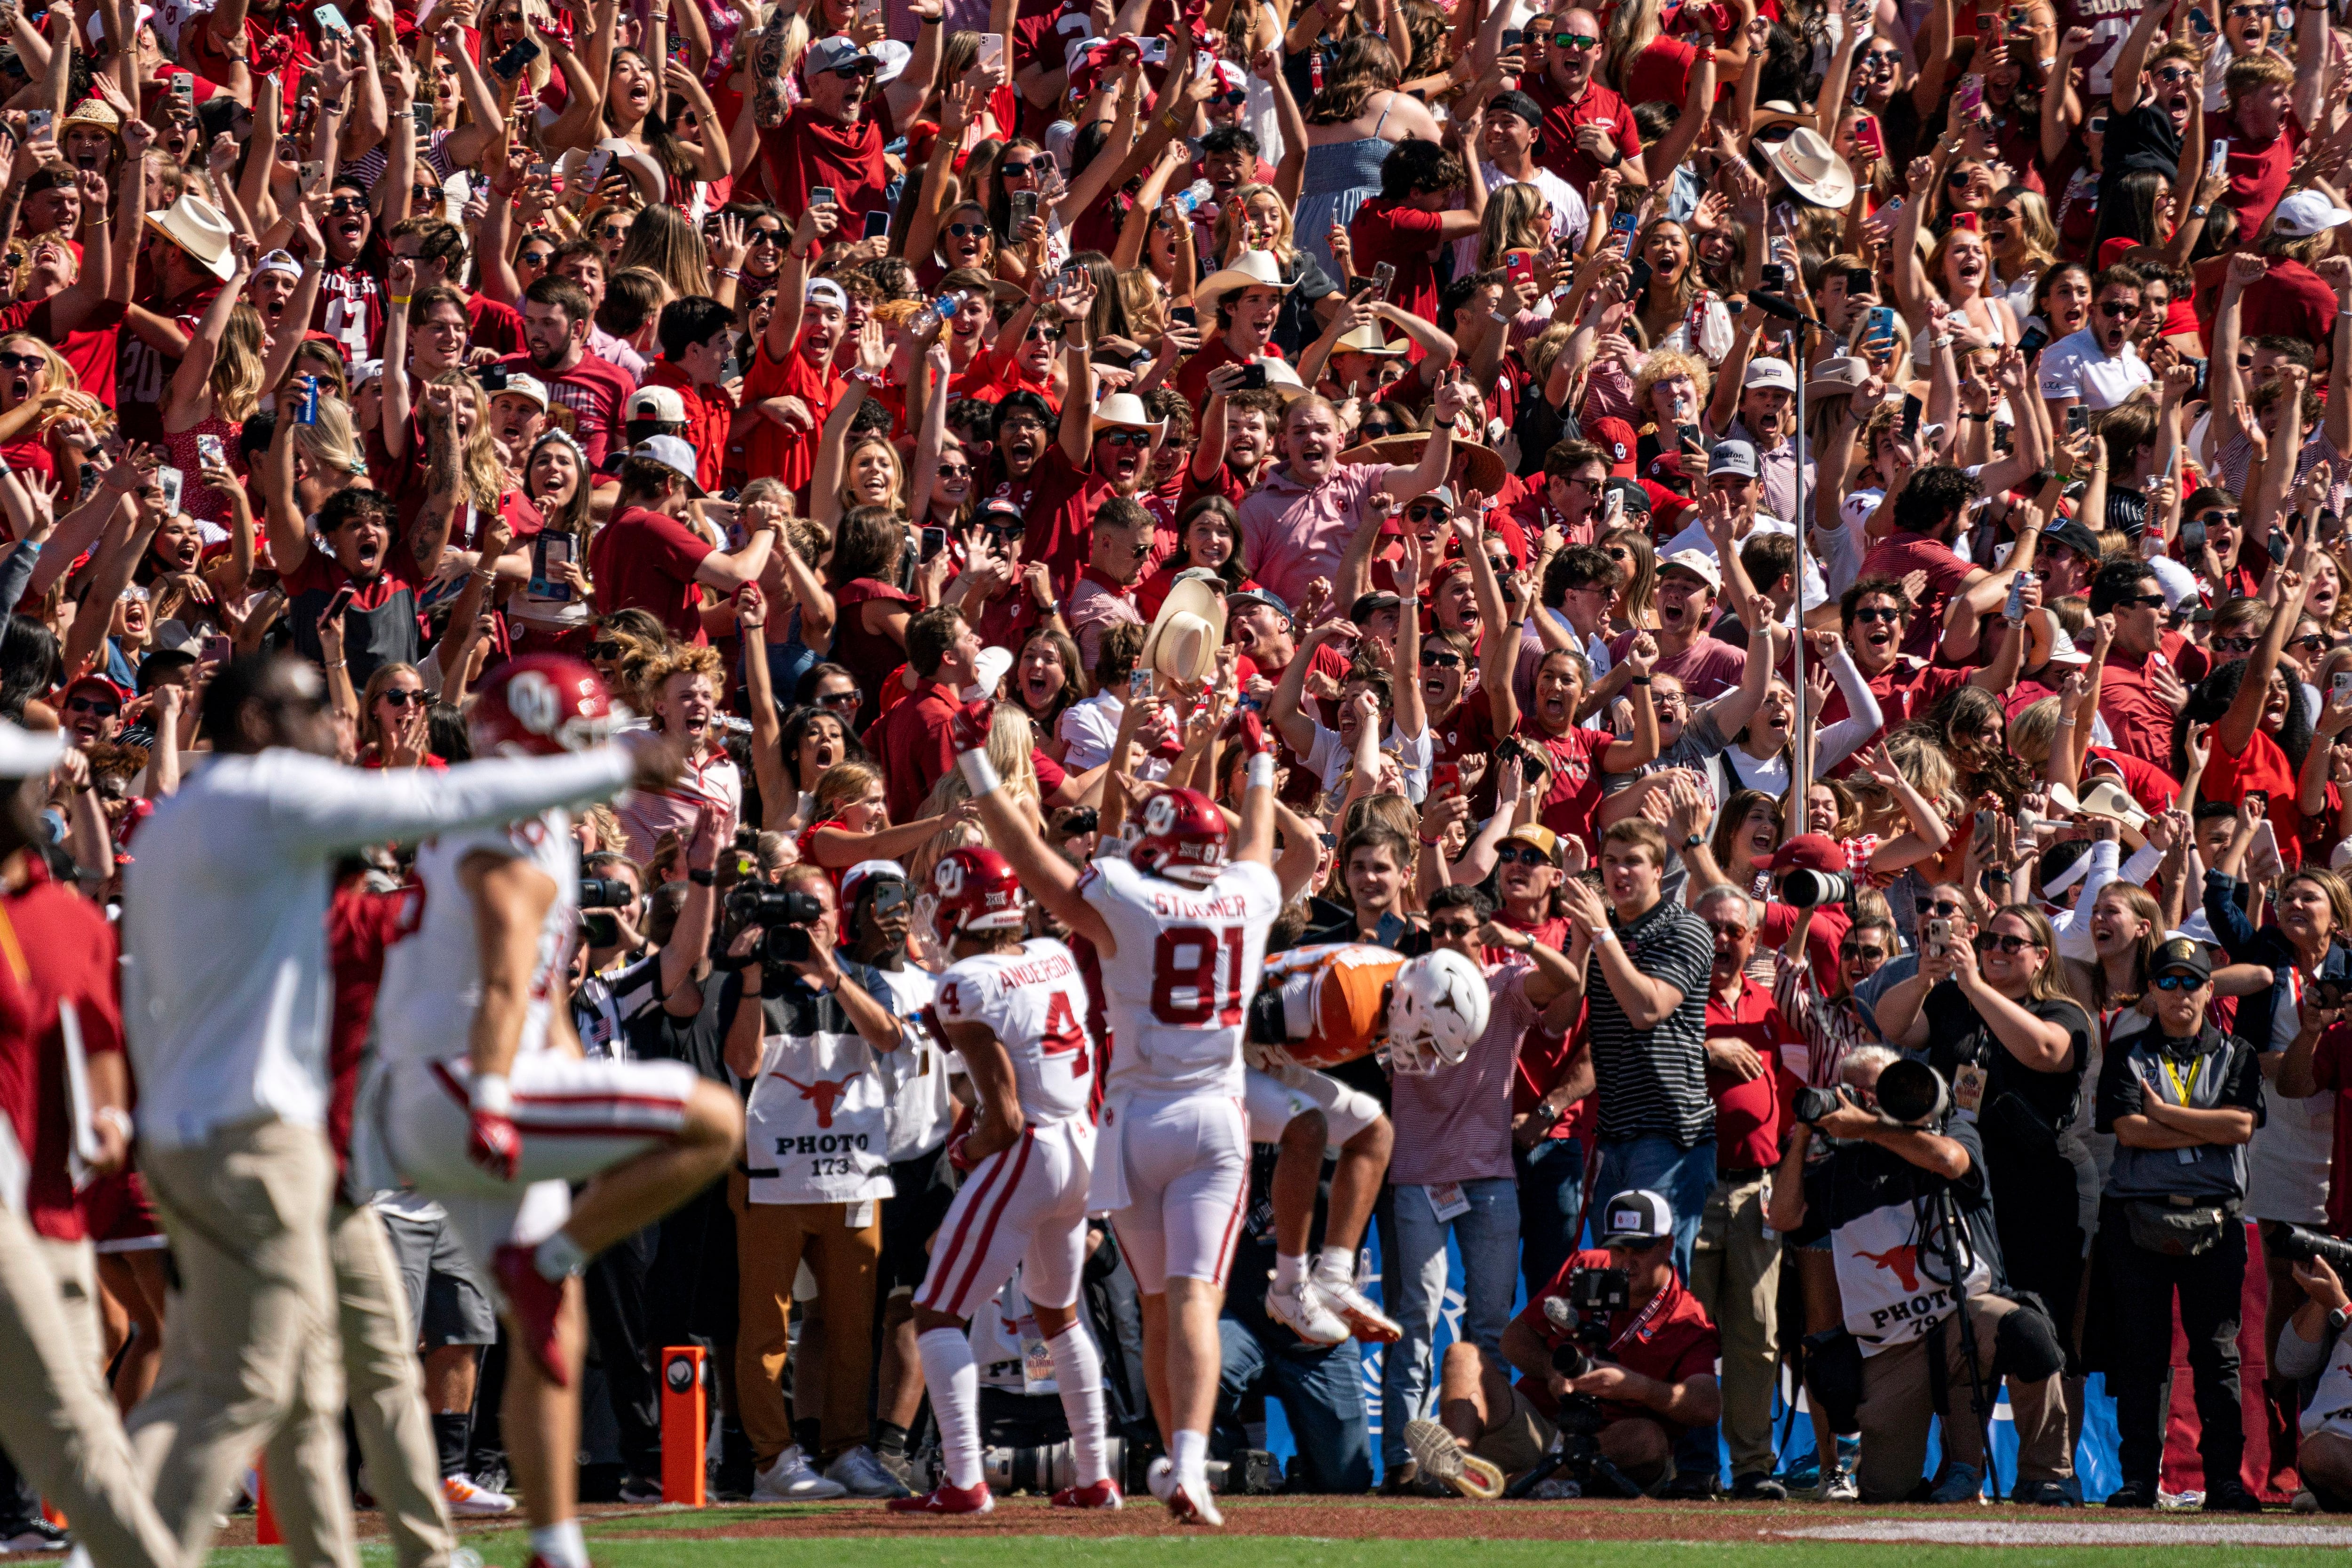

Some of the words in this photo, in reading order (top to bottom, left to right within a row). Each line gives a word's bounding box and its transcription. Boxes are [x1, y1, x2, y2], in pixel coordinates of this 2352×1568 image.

[1615, 443, 1627, 460] OU
[1713, 450, 1745, 461] Paxton
[1652, 463, 1660, 475] OU
[507, 671, 560, 735] OU
[1144, 794, 1176, 836] OU
[935, 858, 964, 898] OU
[1152, 926, 1244, 1030] 81
[938, 983, 961, 1015] 4
[1041, 990, 1089, 1081] 4
[776, 1134, 868, 1155] PHOTO
[811, 1157, 850, 1177] 173
[1869, 1287, 1966, 1330] PHOTO
[1909, 1315, 1939, 1335] 79
